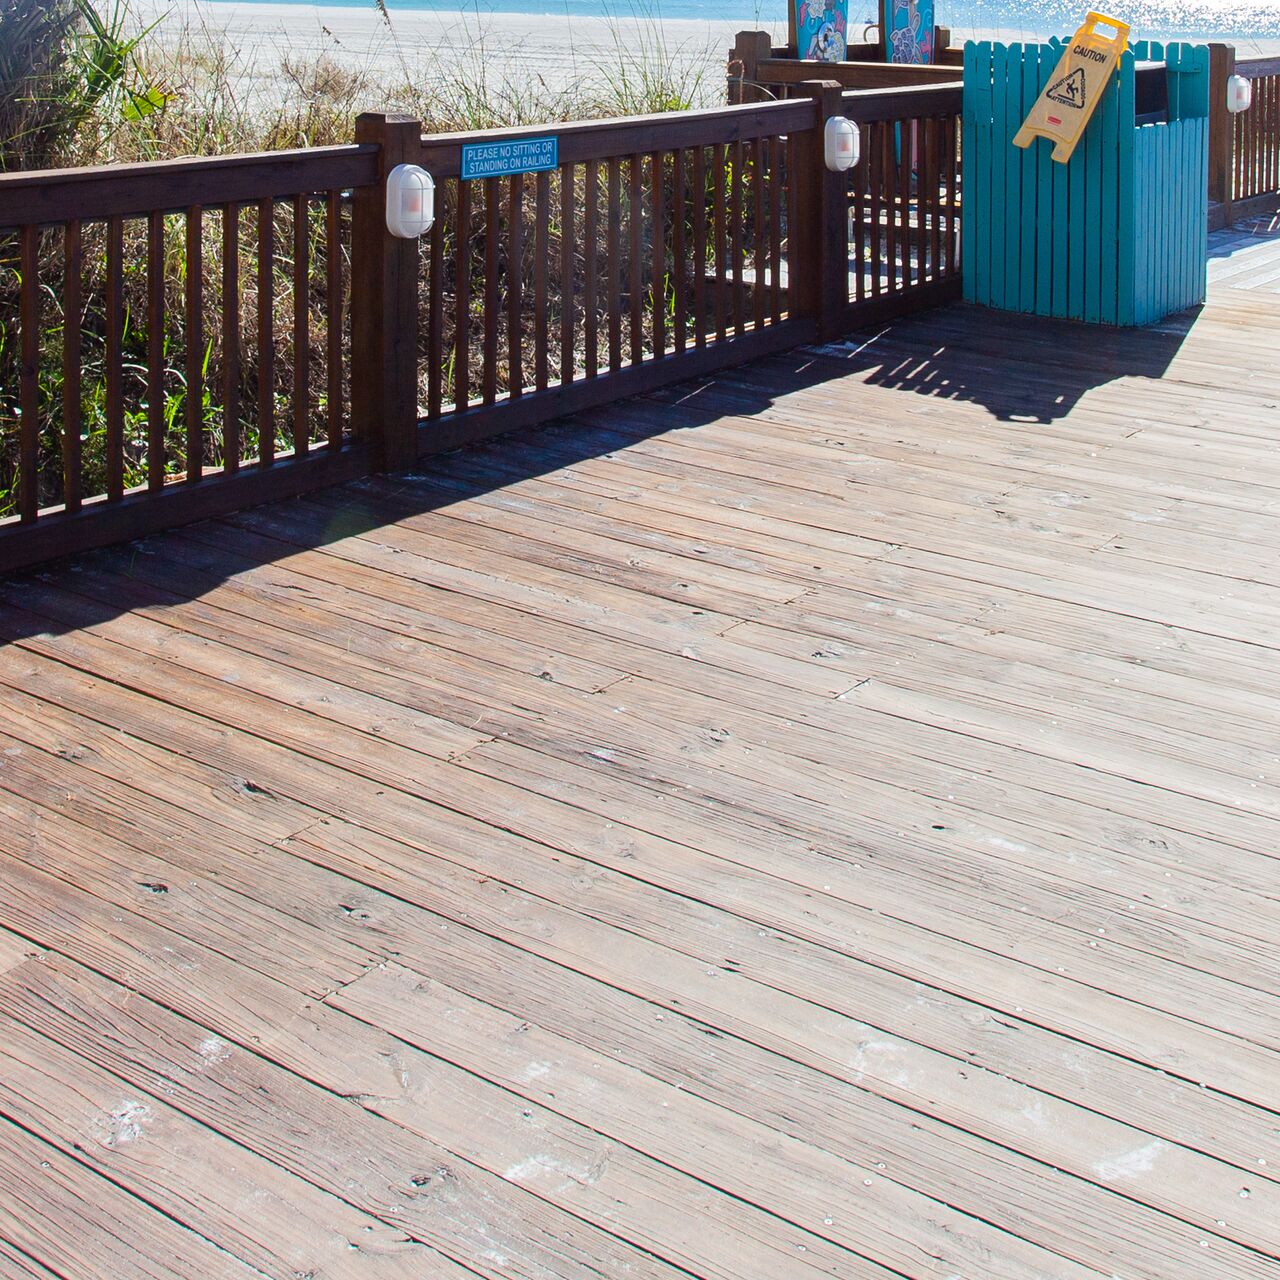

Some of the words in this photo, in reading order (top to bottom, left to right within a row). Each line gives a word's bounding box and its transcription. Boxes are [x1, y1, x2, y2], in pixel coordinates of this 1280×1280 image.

[1073, 45, 1107, 63] CAUTION
[1052, 72, 1074, 90] CAUTION
[467, 147, 498, 161] PLEASE
[500, 146, 511, 157] NO
[512, 143, 541, 156] SITTING
[542, 141, 553, 152] OR
[469, 158, 508, 174] STANDING
[510, 157, 521, 169] ON
[522, 154, 551, 167] RAILING
